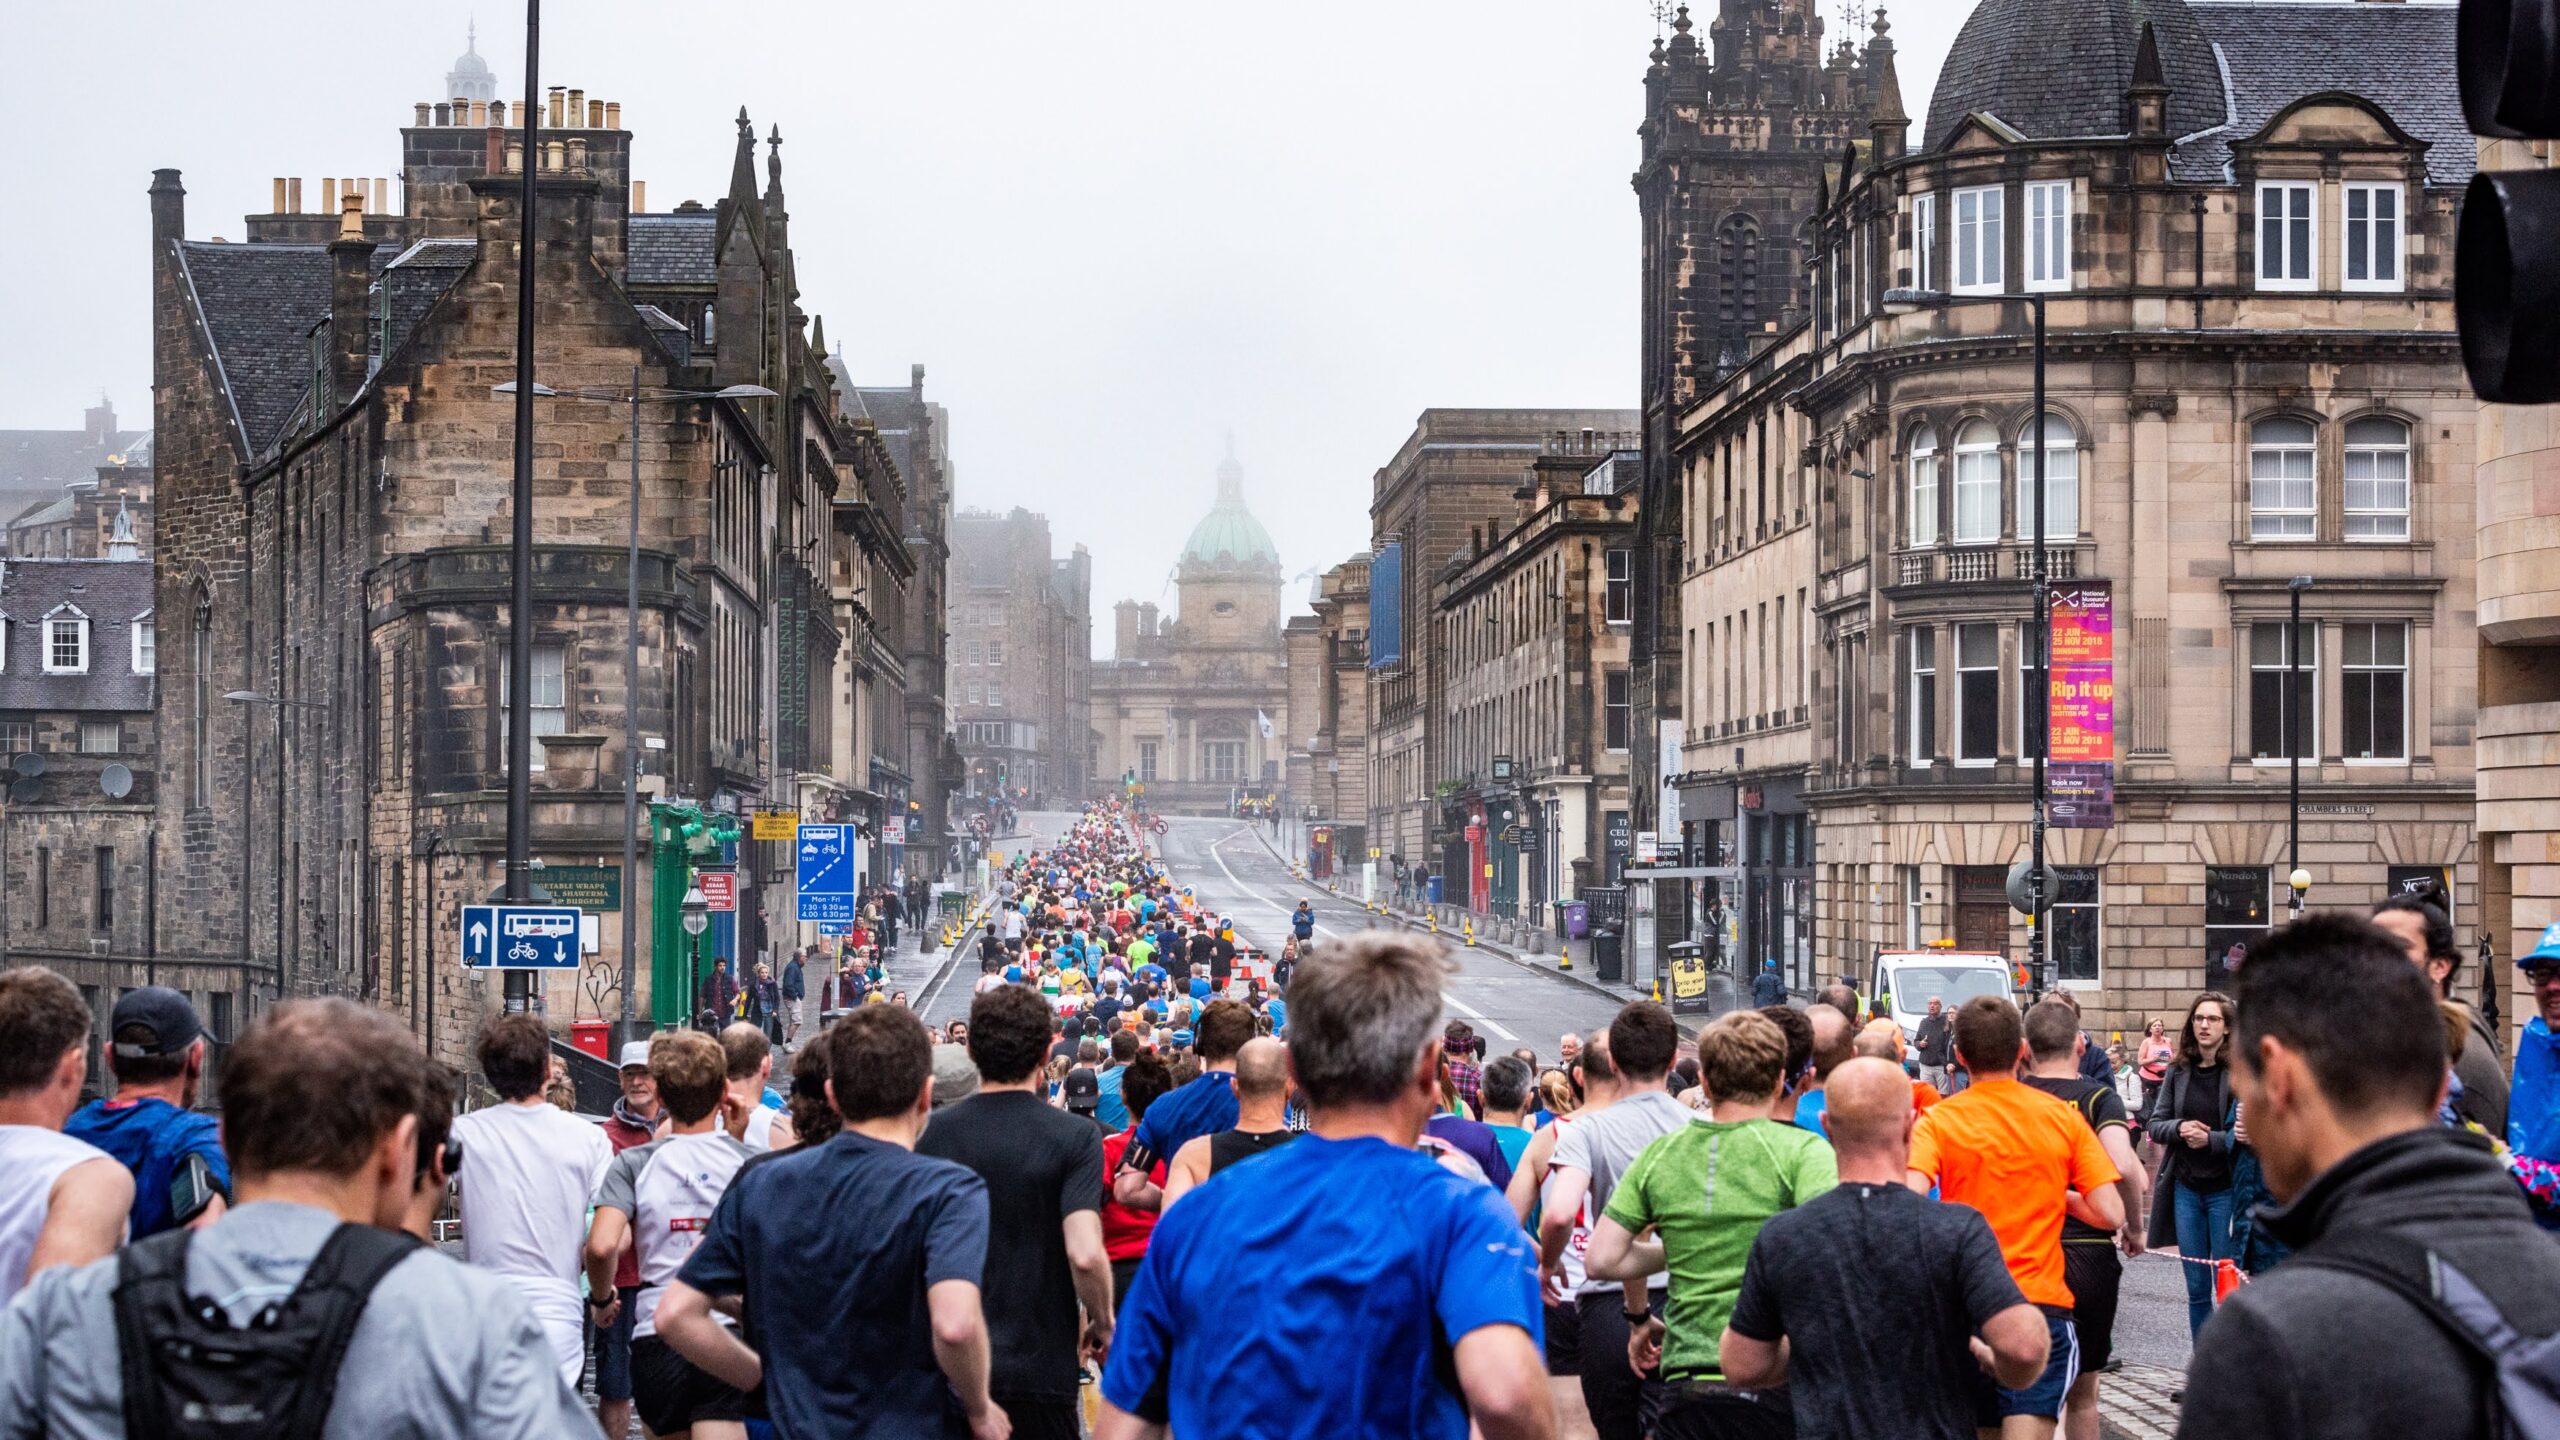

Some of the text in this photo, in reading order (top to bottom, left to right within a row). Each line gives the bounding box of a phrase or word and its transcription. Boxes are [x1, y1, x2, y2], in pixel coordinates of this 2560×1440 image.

[2052, 628, 2062, 636] 22
[2064, 628, 2080, 636] JUN
[2052, 637, 2103, 646] 25 NOV 2018
[780, 598, 794, 720] FRANKENSTEIN
[796, 609, 809, 727] FRANKENSTEIN
[2051, 681, 2112, 700] Rip it up
[2051, 727, 2061, 735] 22
[2063, 727, 2079, 735] JUN
[2051, 736, 2102, 744] 25 NOV 2018
[1667, 740, 1677, 774] Augustin
[561, 871, 617, 881] Paradise
[2056, 871, 2096, 881] Nando's
[2217, 870, 2258, 880] Nando's
